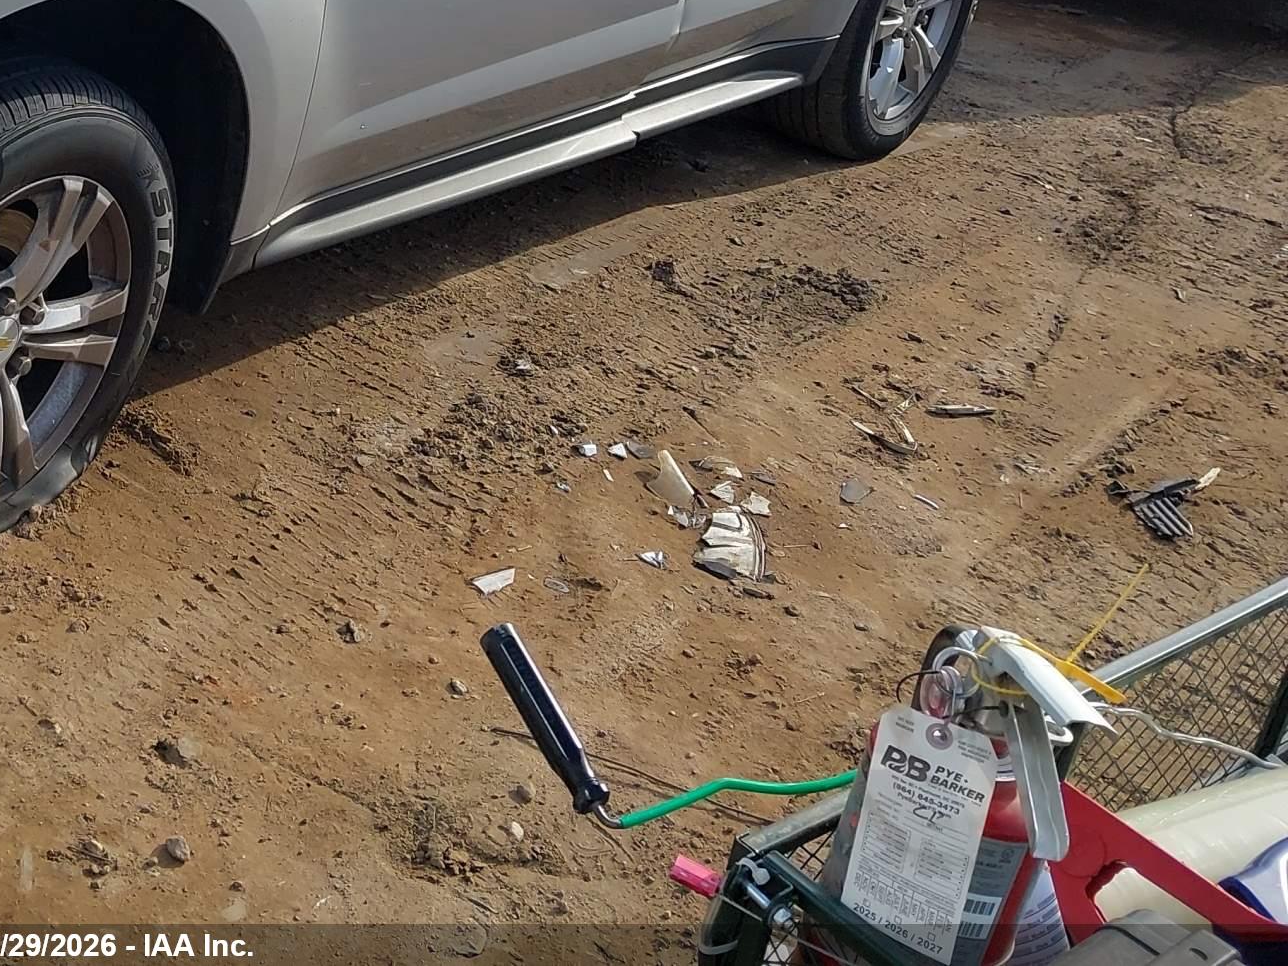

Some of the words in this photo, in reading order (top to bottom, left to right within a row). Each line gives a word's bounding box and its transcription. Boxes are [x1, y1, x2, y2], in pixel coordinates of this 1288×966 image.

[930, 775, 985, 803] BARKER
[917, 793, 960, 815] 845-3473
[853, 902, 877, 922] 2025
[885, 920, 909, 938] 2026
[917, 936, 943, 955] 2027
